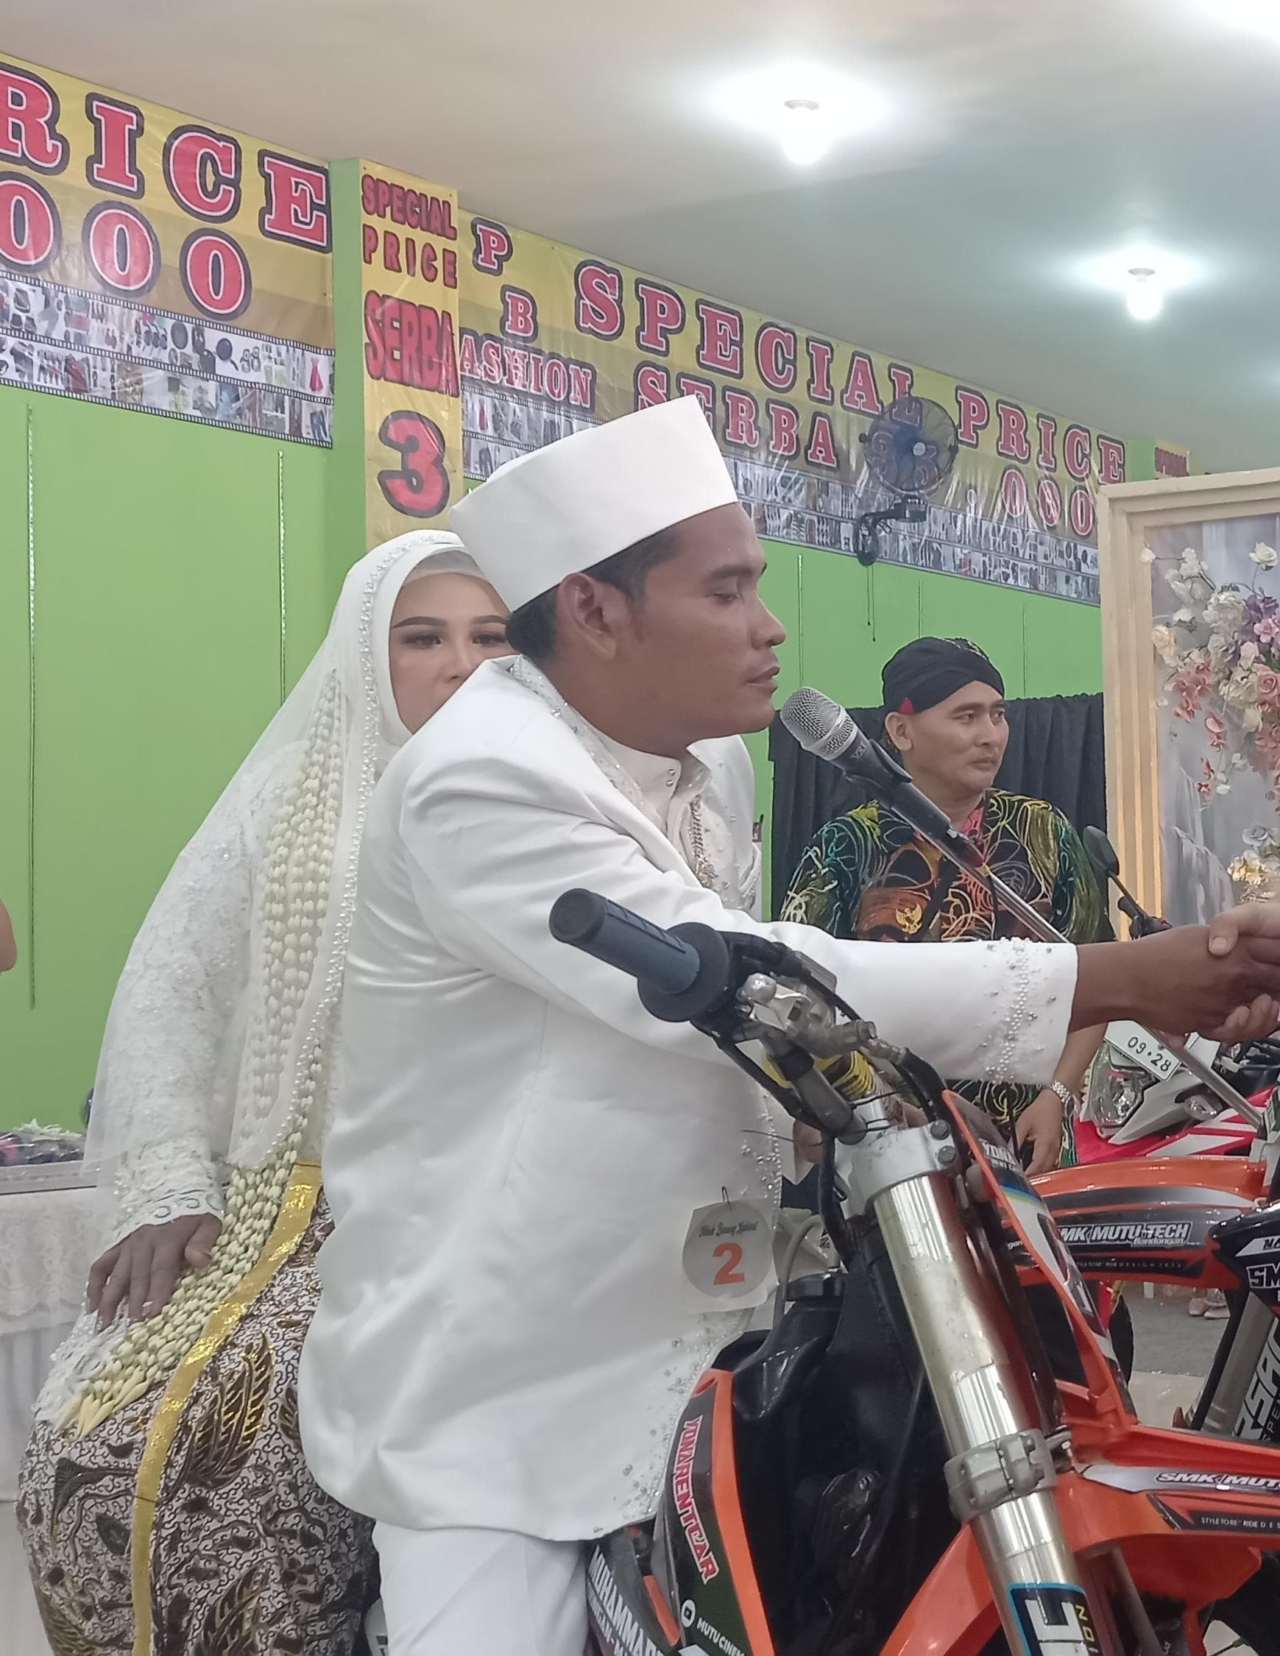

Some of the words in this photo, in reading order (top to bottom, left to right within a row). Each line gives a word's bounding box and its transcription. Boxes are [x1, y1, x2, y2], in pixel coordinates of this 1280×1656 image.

[0, 62, 333, 253] RICE
[361, 174, 457, 241] SPECIAL
[362, 225, 457, 289] PRICE
[472, 217, 513, 275] P
[501, 284, 538, 342] B
[364, 290, 460, 398] SERBA
[574, 259, 923, 432] SPECIAL
[955, 385, 1125, 484] PRICE
[378, 410, 450, 518] 3
[1060, 1226, 1088, 1242] MK
[1091, 1224, 1142, 1241] MUTU
[1146, 1222, 1190, 1239] TECH
[712, 1242, 746, 1286] 2
[1158, 1472, 1219, 1483] SMK
[697, 1617, 721, 1644] MUTU
